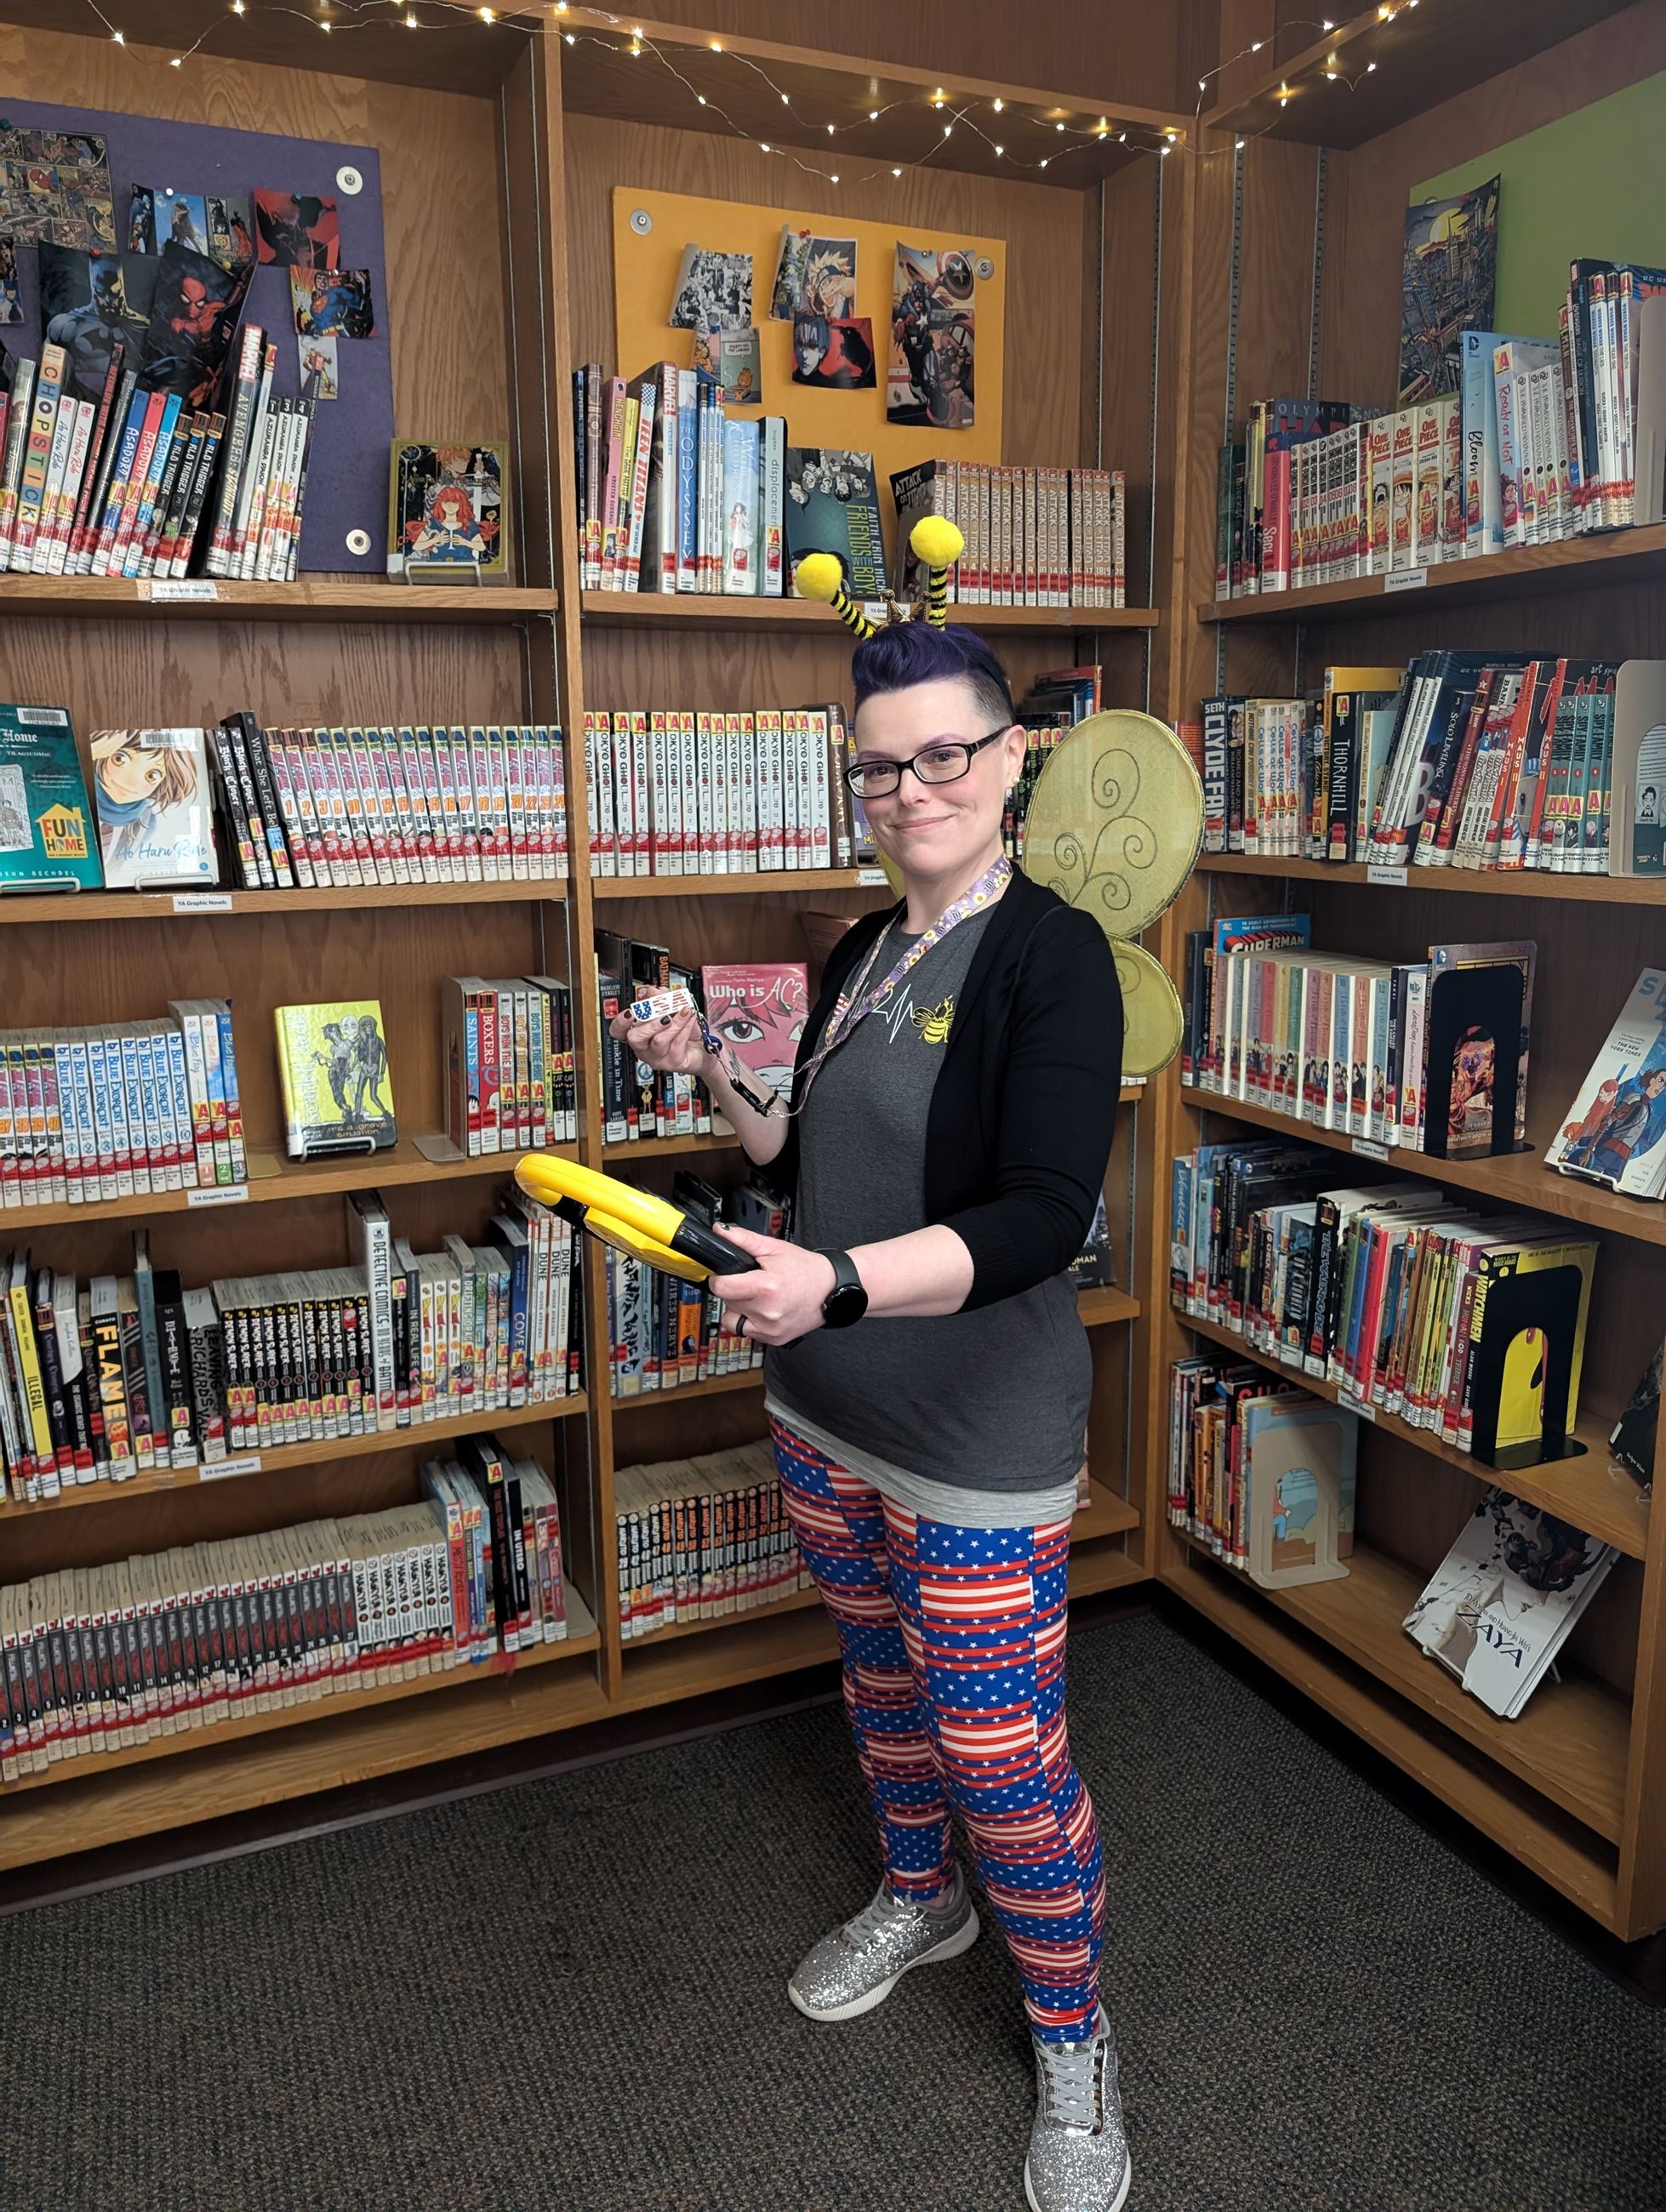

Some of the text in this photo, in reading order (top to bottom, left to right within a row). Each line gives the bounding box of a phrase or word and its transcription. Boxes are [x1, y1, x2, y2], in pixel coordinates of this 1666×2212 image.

[238, 328, 261, 381] MARVEL
[663, 365, 676, 414] MARVEL
[613, 398, 623, 442] HENCHGIRL
[1374, 432, 1389, 444] ONE
[1395, 426, 1410, 438] ONE
[1498, 384, 1512, 465] Ready or Not
[22, 366, 58, 518] CHOPSTICK
[258, 417, 274, 485] AZUMANGA DAIOH
[1372, 442, 1390, 454] PIECE
[1394, 436, 1412, 448] PIECE
[1469, 431, 1483, 477] Bloom
[635, 418, 651, 515] TEEN TITANS
[895, 469, 921, 497] ATTACK
[223, 467, 238, 518] STANDOFF
[847, 505, 876, 589] FRIENDS WITH BOY
[869, 506, 886, 594] FAITH ERIN HICK
[1205, 702, 1224, 714] SETH
[3, 728, 38, 743] Home
[1436, 711, 1458, 778] SOLO LEVELING
[1541, 735, 1552, 767] MAUS
[219, 745, 240, 807] Black Clover
[234, 745, 254, 806] Black Clover
[252, 738, 260, 765] What
[257, 769, 265, 787] She
[261, 788, 271, 811] Left
[1205, 715, 1225, 818] CLYDE FAN
[1290, 755, 1297, 767] at
[1501, 742, 1512, 772] MAUS
[1330, 739, 1349, 816] THORNHILL
[348, 797, 360, 813] 10
[382, 797, 394, 812] 12
[43, 818, 82, 838] FUN
[47, 837, 84, 852] HOME
[140, 842, 172, 859] Haru
[186, 899, 208, 908] Graphic
[659, 955, 669, 989] BATMAN
[710, 977, 803, 1003] Who is AC?
[467, 1018, 477, 1065] SAINTS
[483, 1015, 494, 1064] BOXERS
[170, 1048, 188, 1116] BLUE EXORCIST
[613, 1069, 621, 1077] in
[58, 1061, 75, 1130] BLUE EXORCIST
[16, 1118, 30, 1132] 38
[31, 1117, 44, 1132] 39
[48, 1117, 60, 1132] 40
[336, 1128, 379, 1137] situation
[358, 1122, 387, 1131] grave
[203, 1193, 223, 1201] Graphic
[374, 1241, 389, 1288] DETECTIVE
[539, 1252, 548, 1281] DUNE
[1314, 1230, 1332, 1335] THE WALKING DEA
[1464, 1286, 1473, 1304] WICKS
[1470, 1274, 1489, 1343] WATCHMEN
[358, 1306, 370, 1354] DEMON SLAYER
[410, 1309, 419, 1366] IN REAL LIFE
[667, 1318, 677, 1356] NERVE
[96, 1325, 127, 1420] FLAME
[379, 1365, 392, 1389] BATM
[26, 1375, 43, 1411] ILLEGAL
[514, 1530, 524, 1571] IN UTERO
[1456, 1604, 1522, 1668] ZAYA
